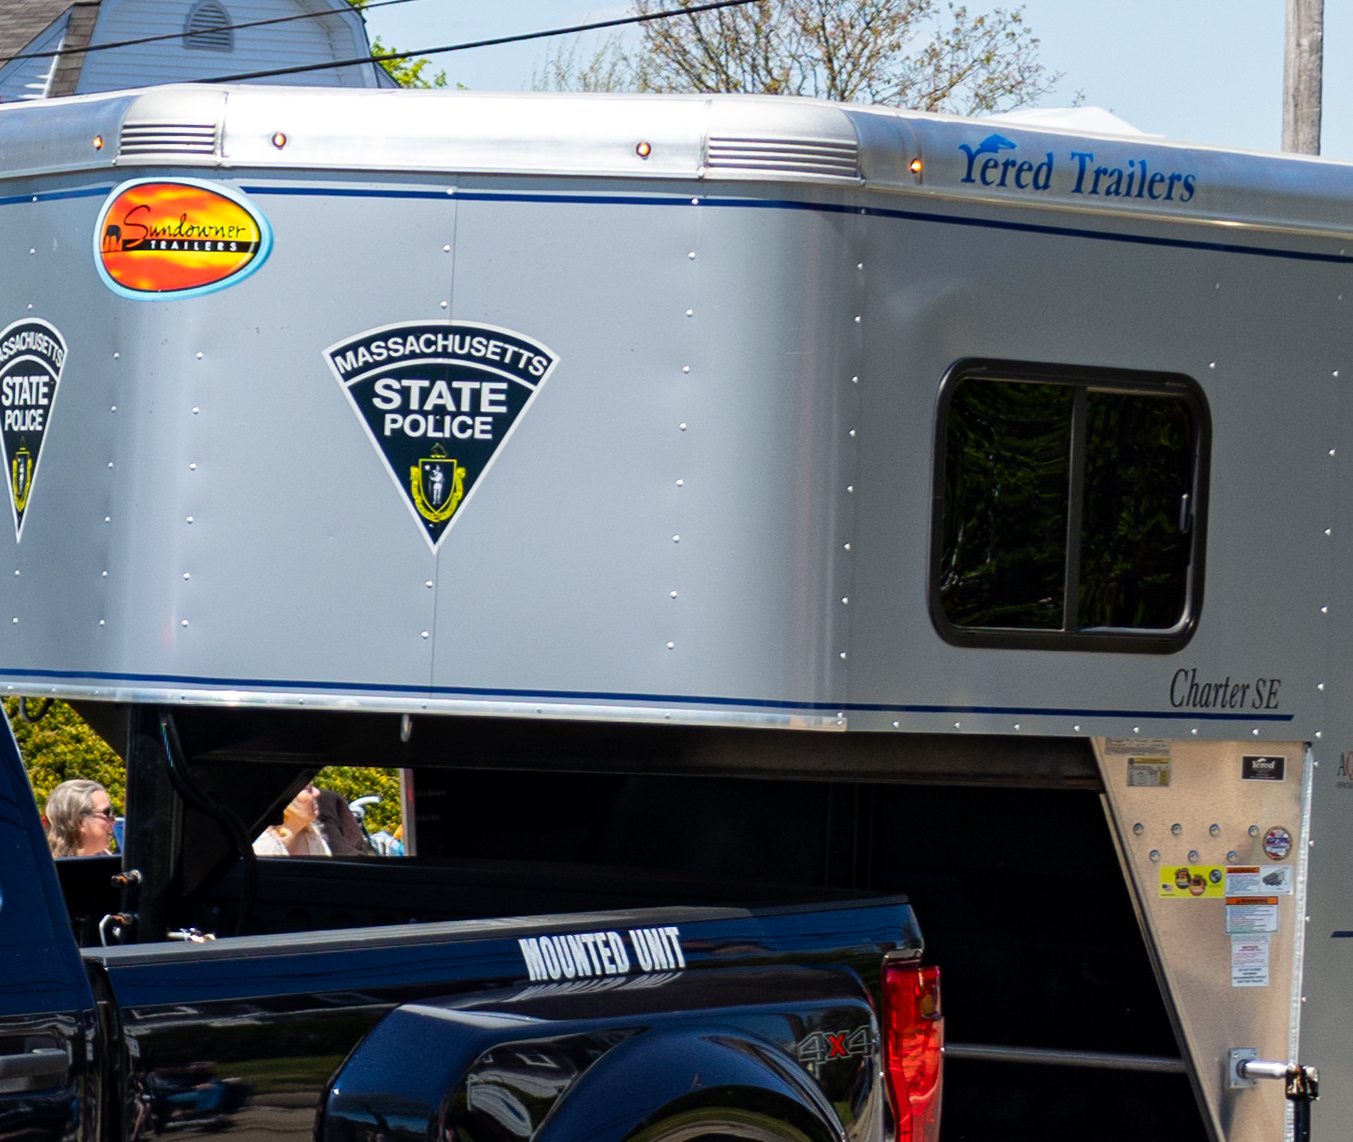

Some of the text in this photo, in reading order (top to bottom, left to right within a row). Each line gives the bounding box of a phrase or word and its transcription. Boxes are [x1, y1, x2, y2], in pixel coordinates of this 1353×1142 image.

[958, 141, 1196, 203] Yered Trailers
[124, 204, 246, 248] Sundowner
[150, 240, 238, 251] TRAILERS
[334, 333, 548, 377] MASSACHUSETTS
[1, 375, 50, 406] STATE
[372, 378, 508, 413] STATE
[4, 408, 44, 431] POLICE
[384, 413, 493, 440] POLICE
[1169, 668, 1281, 709] Charter SE
[518, 926, 686, 982] MOUNTED UNIT
